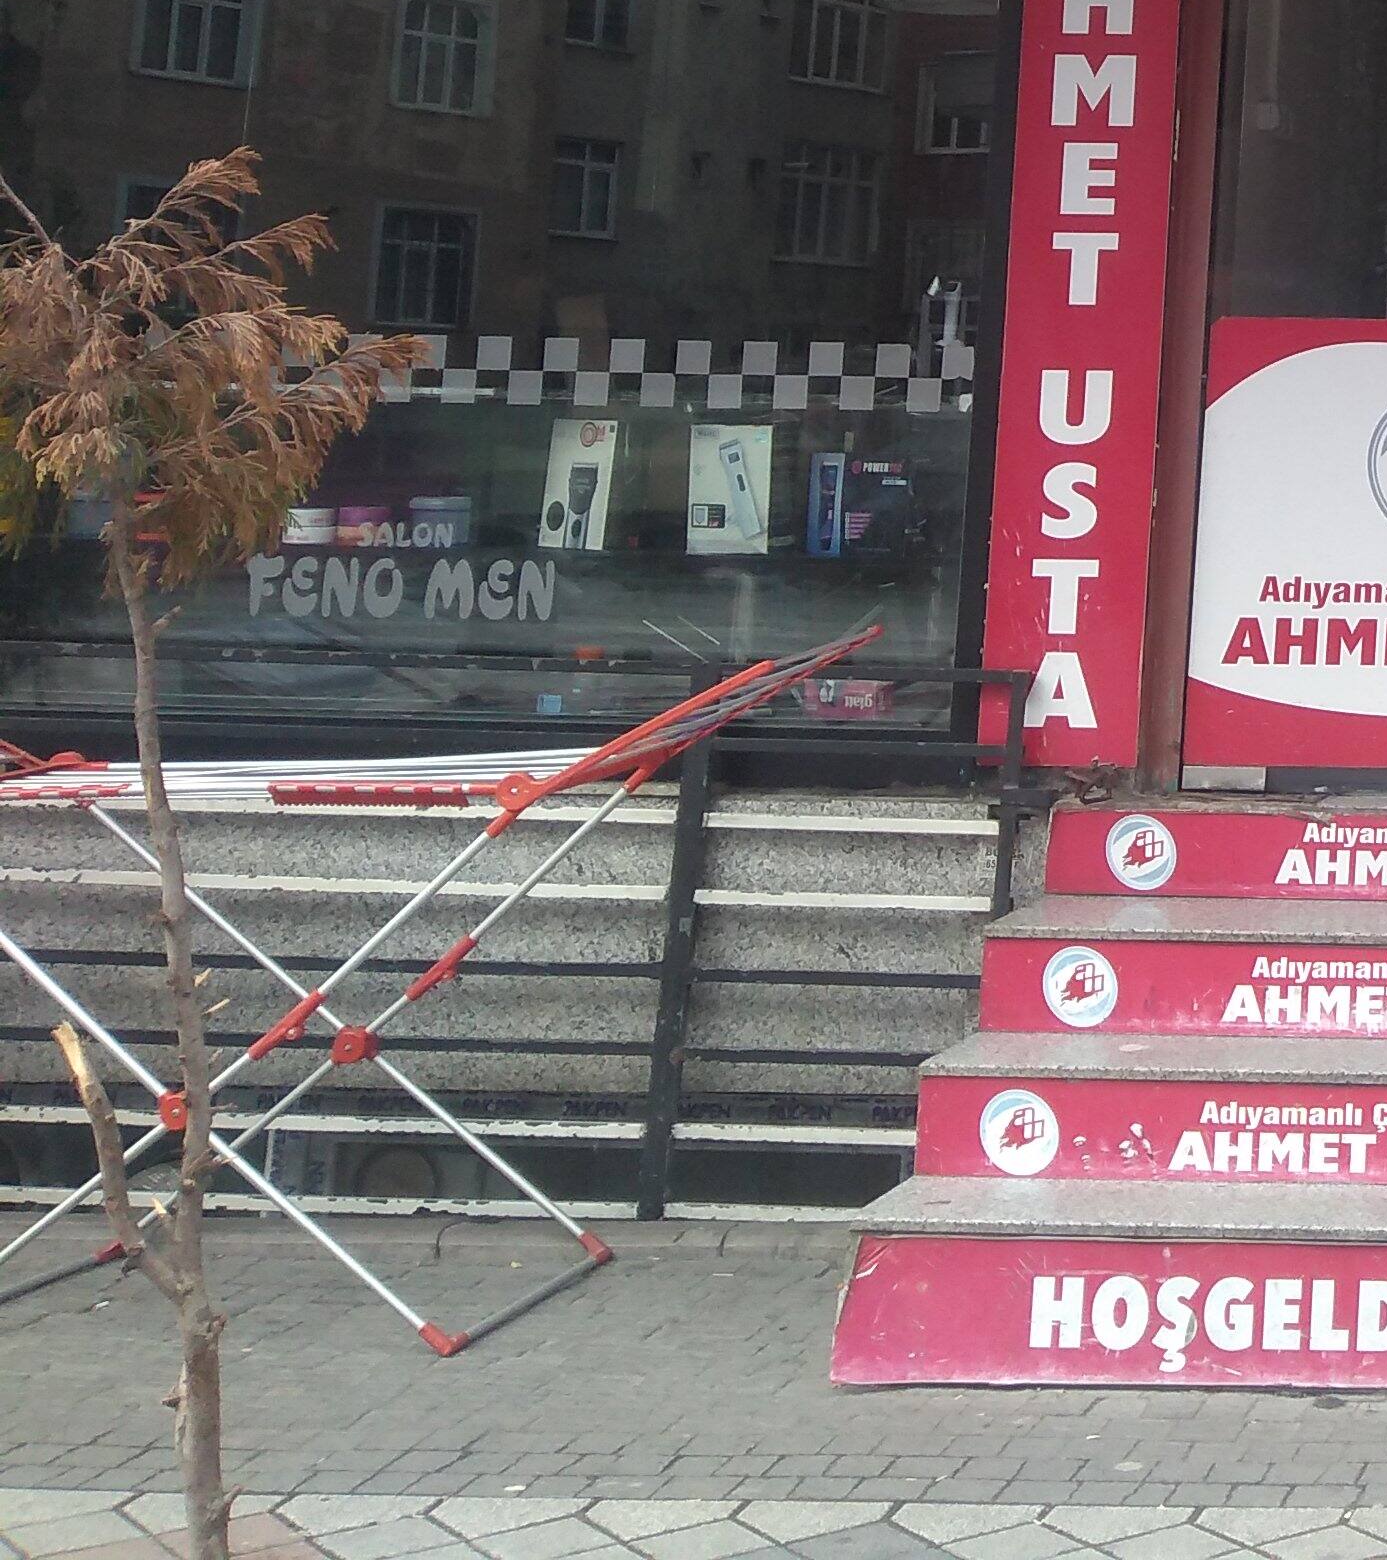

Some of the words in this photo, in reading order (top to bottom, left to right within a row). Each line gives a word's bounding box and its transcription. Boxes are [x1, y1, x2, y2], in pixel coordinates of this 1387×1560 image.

[356, 521, 455, 548] SALON
[1022, 369, 1115, 729] USTA
[246, 553, 404, 620] FENO
[423, 558, 556, 622] MEN
[1200, 1100, 1362, 1130] Adıyamanlı
[1168, 1130, 1377, 1175] AHMET
